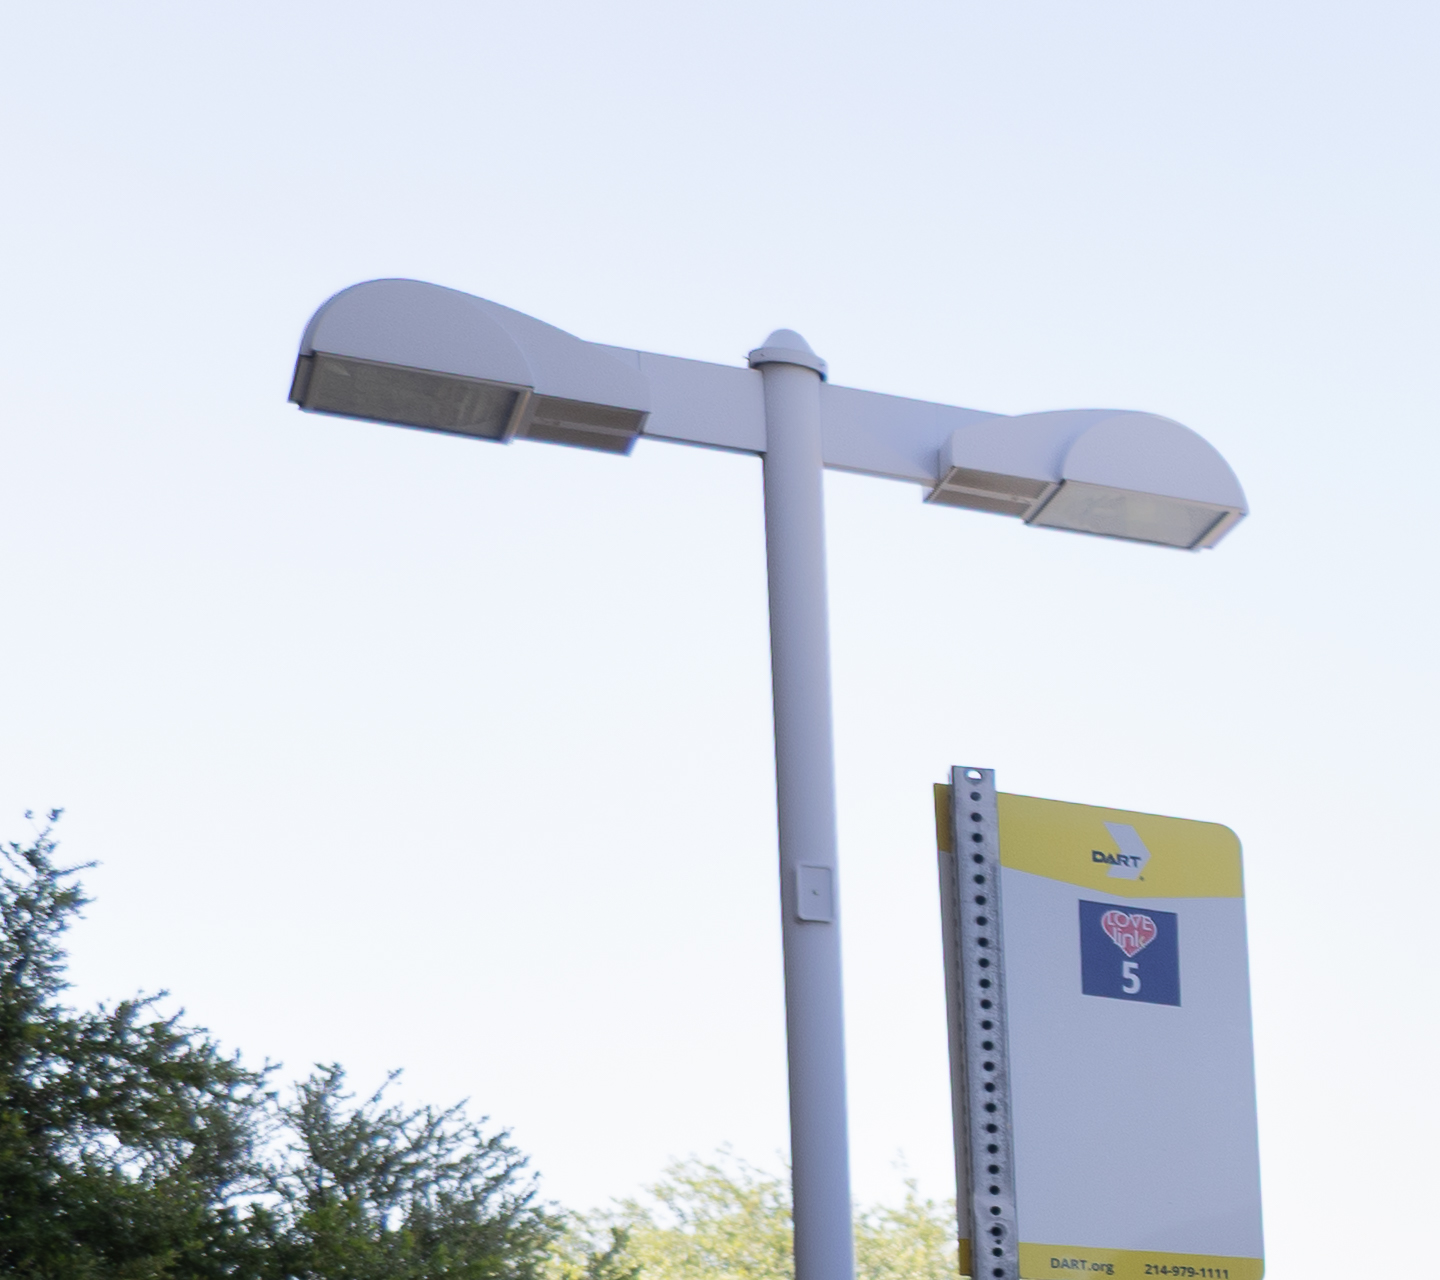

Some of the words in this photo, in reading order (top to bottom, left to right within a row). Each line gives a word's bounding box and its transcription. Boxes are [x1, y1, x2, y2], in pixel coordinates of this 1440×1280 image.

[1091, 849, 1142, 868] DART
[1106, 911, 1153, 932] LOVE
[1121, 960, 1141, 995] 5
[1050, 1257, 1115, 1276] DART.org
[1144, 1263, 1230, 1280] 214-979-1111
